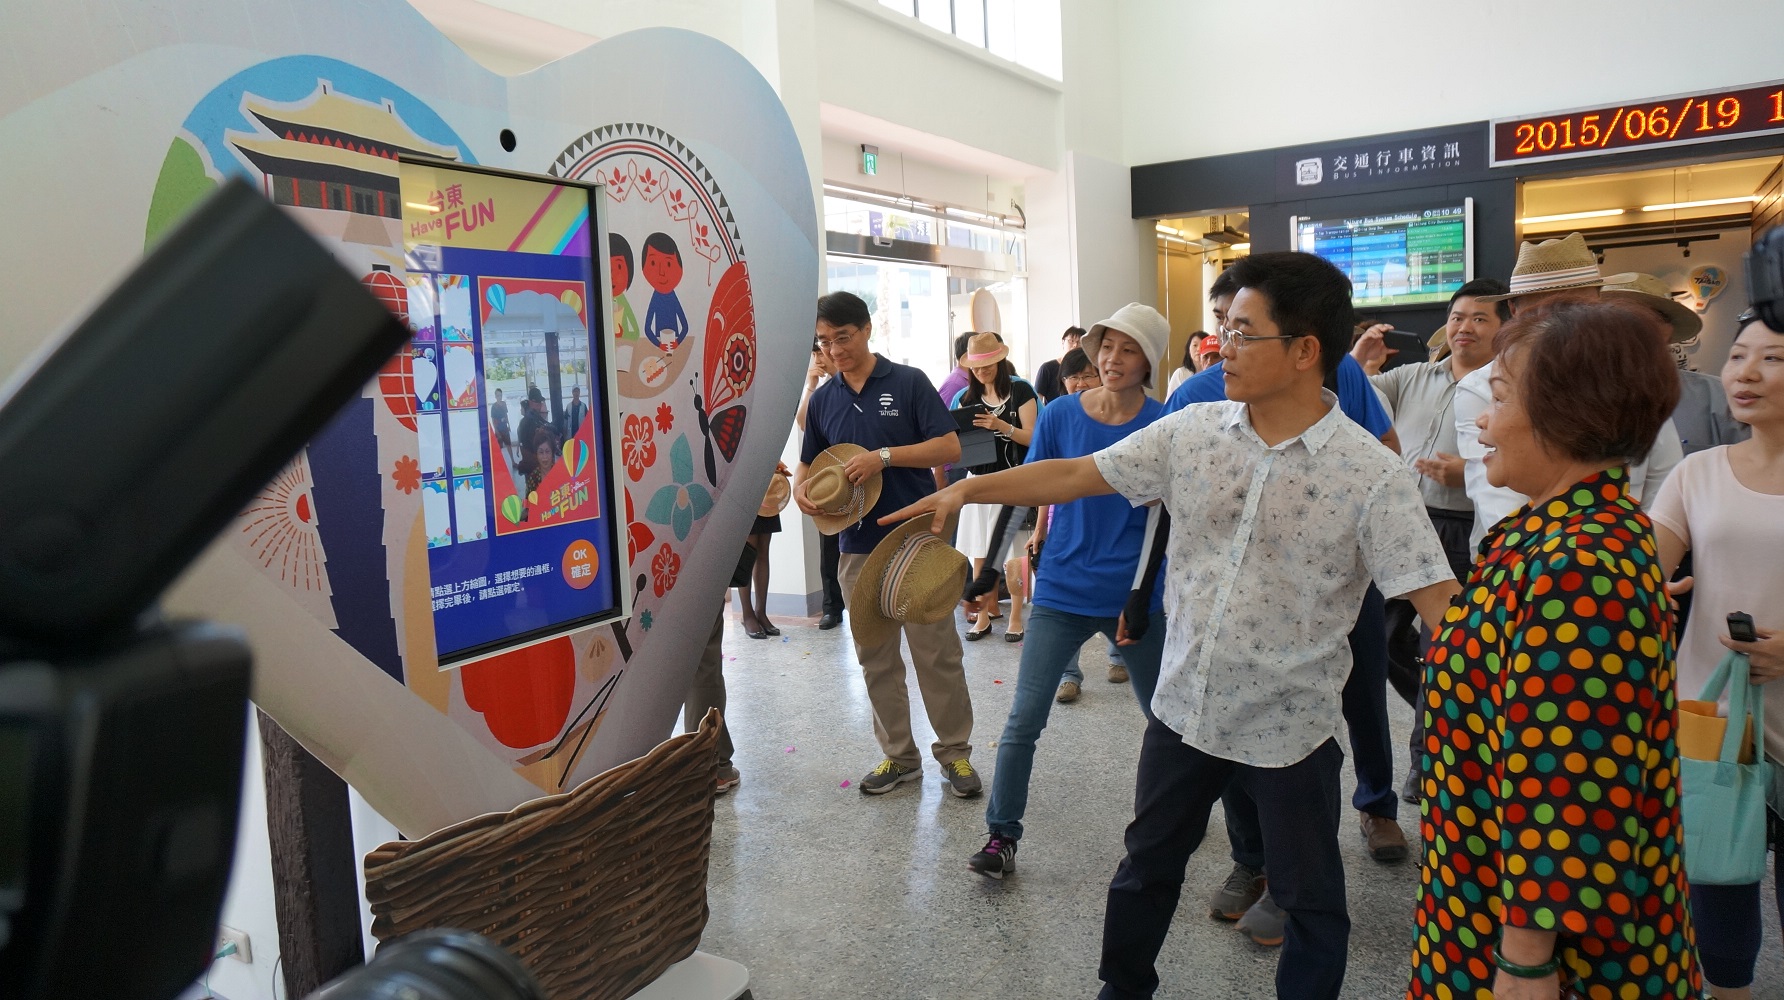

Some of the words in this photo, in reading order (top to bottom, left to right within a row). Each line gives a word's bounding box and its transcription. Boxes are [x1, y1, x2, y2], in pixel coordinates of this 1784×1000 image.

[1515, 97, 1741, 153] 2015/06/19
[1333, 141, 1460, 172] 交通行車資訊
[426, 184, 464, 215] 台東
[410, 219, 442, 238] Have
[445, 197, 495, 240] FUN
[550, 482, 571, 507] 台東
[559, 486, 588, 518] FUN
[573, 548, 588, 561] OK
[570, 563, 591, 579] 確定
